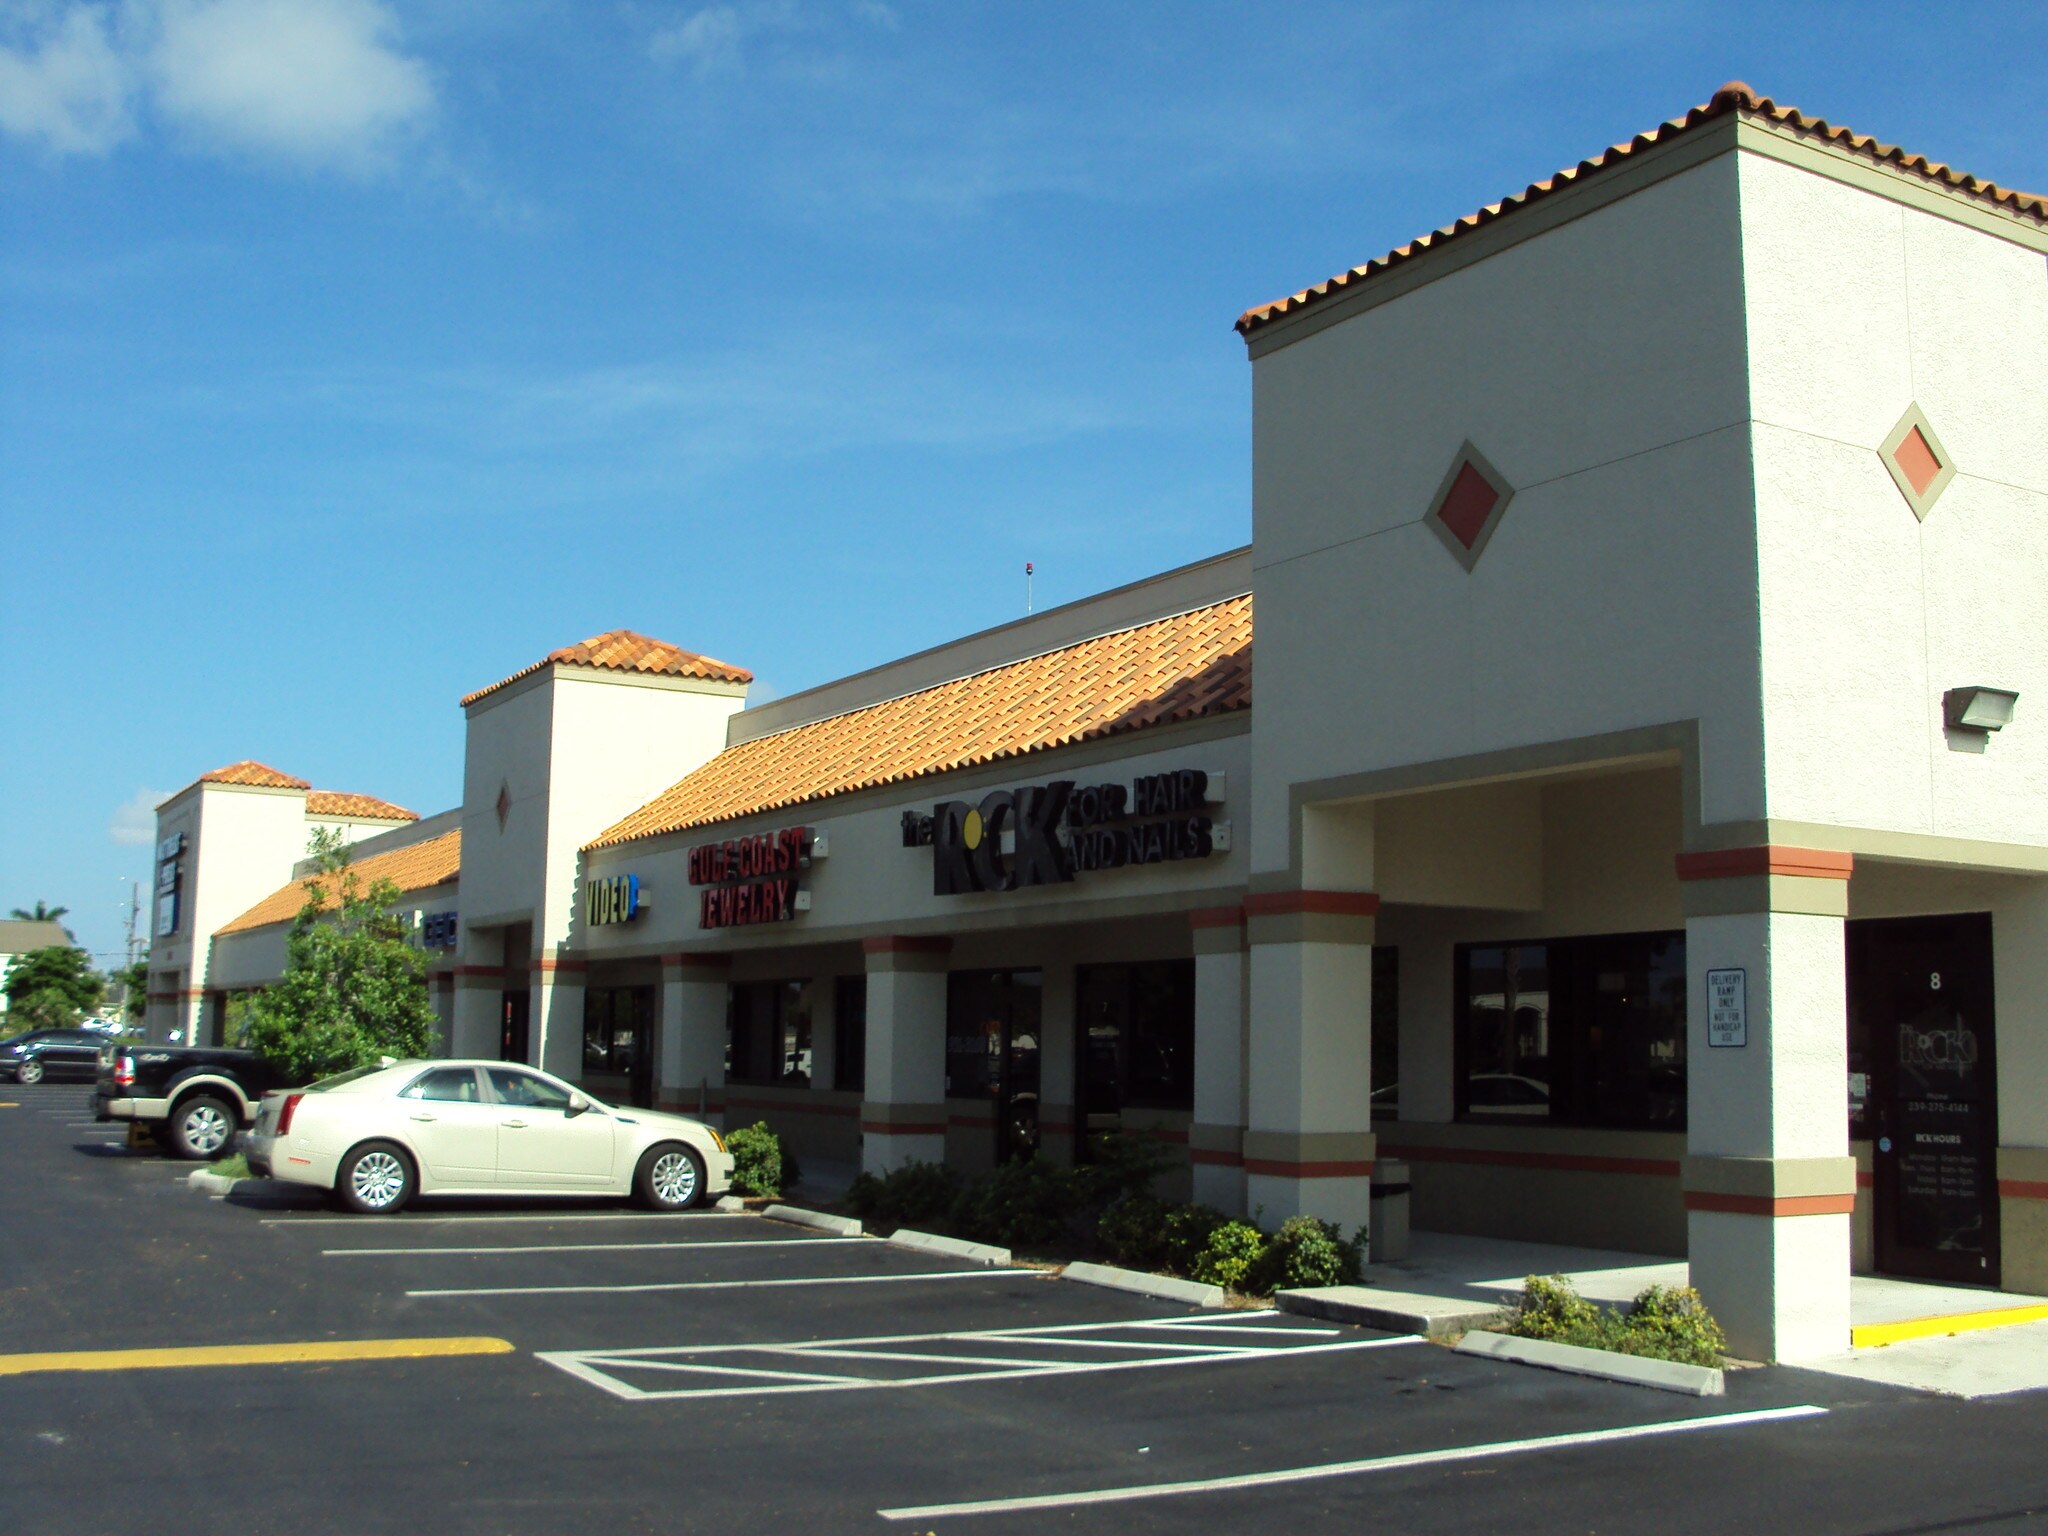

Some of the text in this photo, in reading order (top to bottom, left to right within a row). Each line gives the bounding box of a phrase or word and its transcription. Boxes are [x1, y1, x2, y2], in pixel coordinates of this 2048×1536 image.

[1066, 769, 1208, 827] FOR HAIR
[1065, 817, 1213, 872] AND NAILS
[688, 827, 813, 885] GULF COAST
[586, 873, 639, 926] VIDEO
[700, 879, 795, 929] JEWELRY
[1711, 974, 1742, 985] DELIVERY
[1930, 972, 1941, 990] 8
[1717, 985, 1736, 996] RAMP
[1719, 997, 1734, 1008] ONLY
[1712, 1022, 1742, 1032] HANDICAP
[1933, 1134, 1961, 1144] HOURS
